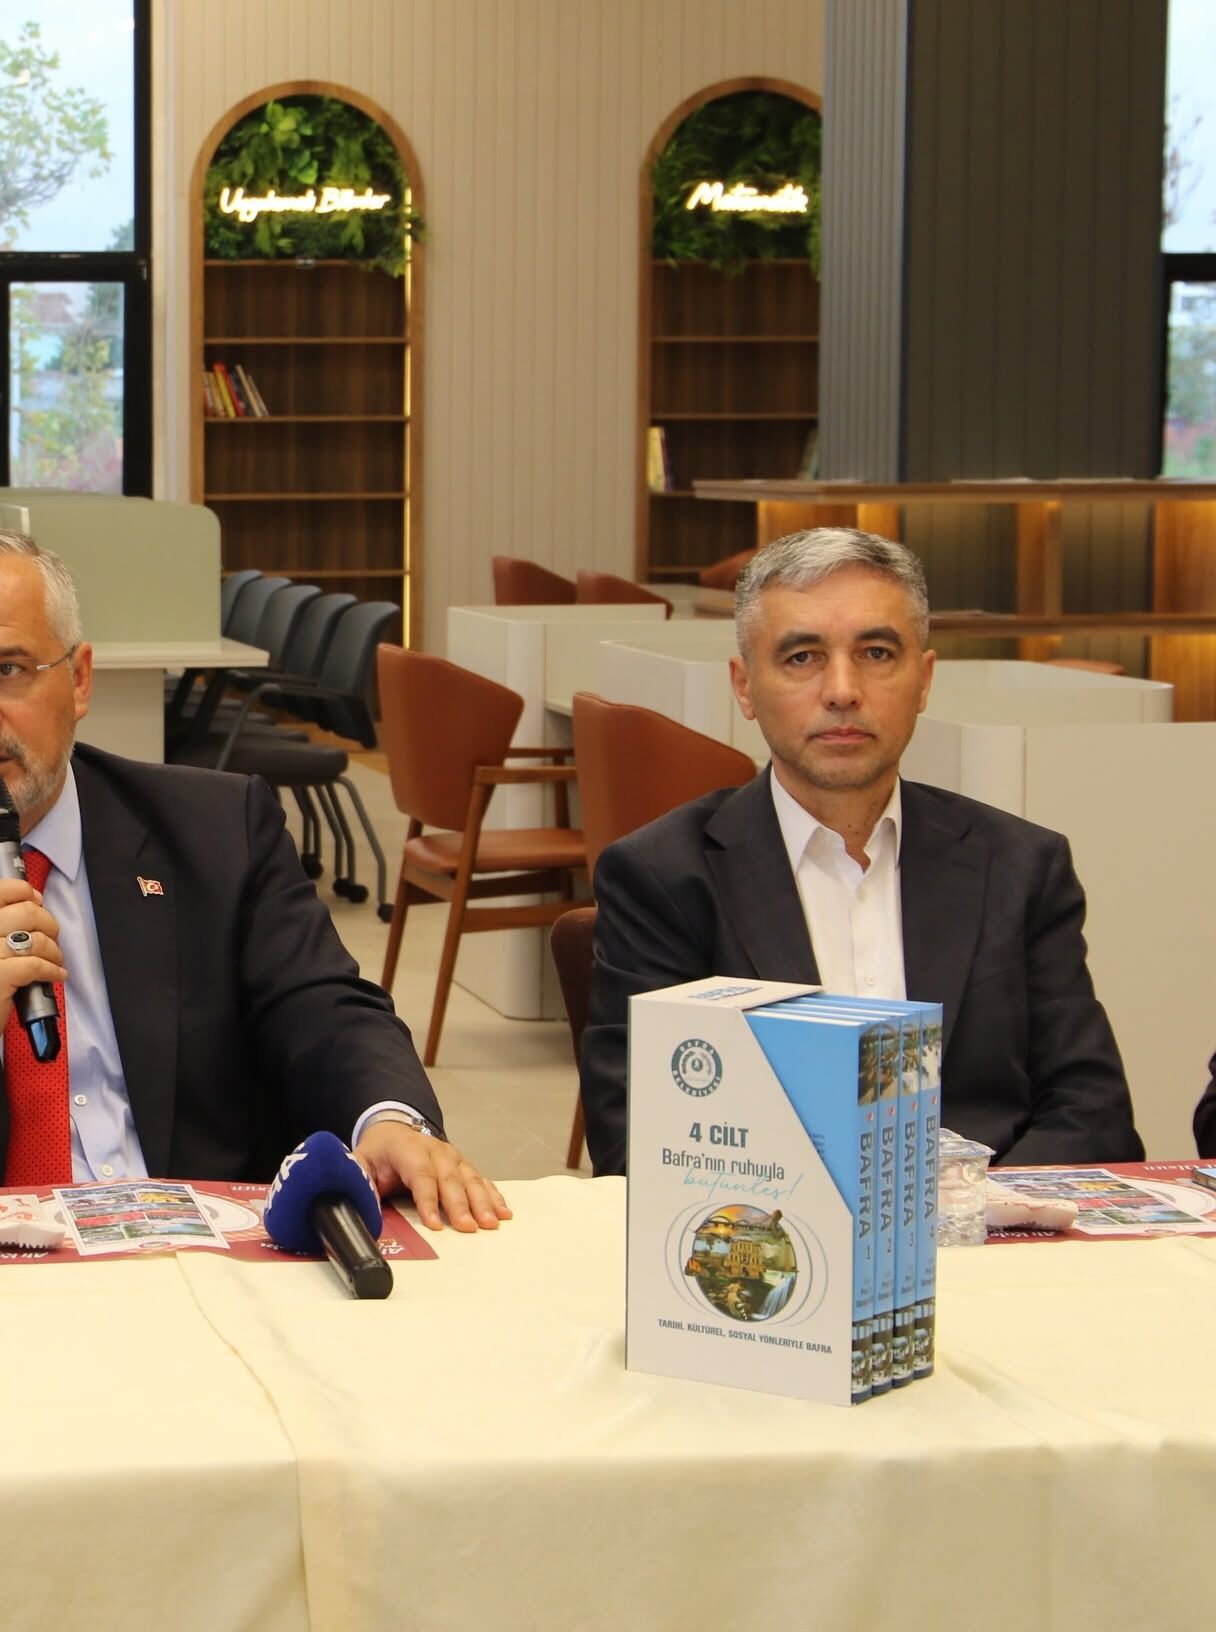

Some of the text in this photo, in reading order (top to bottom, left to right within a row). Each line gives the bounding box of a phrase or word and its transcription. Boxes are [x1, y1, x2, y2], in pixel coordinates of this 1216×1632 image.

[662, 1148, 785, 1182] Bafra'nın ruhuyla
[689, 1122, 749, 1149] 4 CİLT
[903, 1120, 916, 1226] BAFRA
[924, 1114, 937, 1219] BAFRA
[858, 1130, 873, 1240] BAFRA
[866, 1244, 871, 1260] 1
[880, 1125, 894, 1253] BAFRA 2
[728, 1329, 757, 1342] SOSYAL
[806, 1342, 833, 1355] BAFRA
